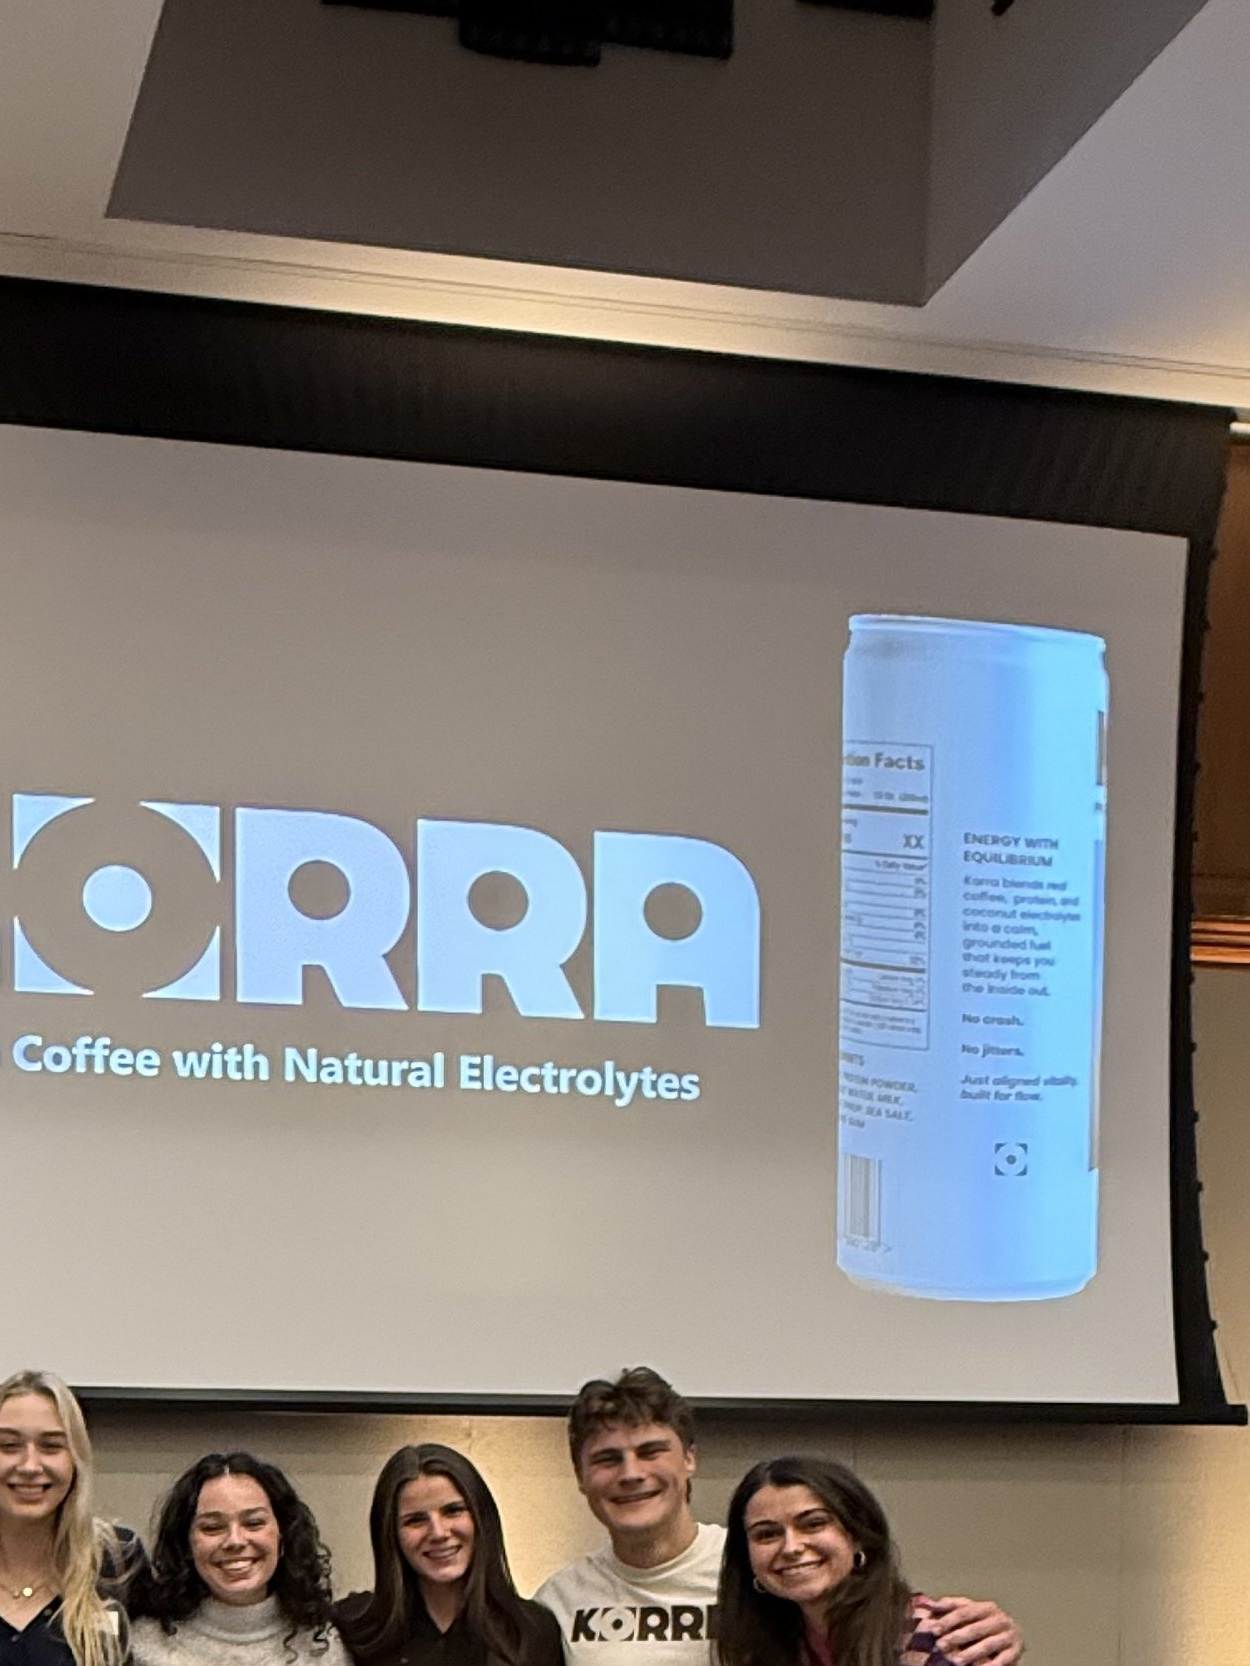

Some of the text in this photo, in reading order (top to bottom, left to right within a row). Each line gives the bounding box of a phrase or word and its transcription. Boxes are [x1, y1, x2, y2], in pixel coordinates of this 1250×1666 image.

[874, 752, 926, 771] Facts
[902, 833, 926, 850] XX
[964, 832, 1058, 850] ENERGY WITH
[964, 850, 1053, 867] EQUILIBRIUM
[962, 1013, 981, 1024] No
[961, 1043, 980, 1055] No
[12, 1034, 161, 1076] Coffee
[172, 1042, 270, 1080] with
[283, 1046, 445, 1089] Natural
[459, 1054, 700, 1107] Electrolytes
